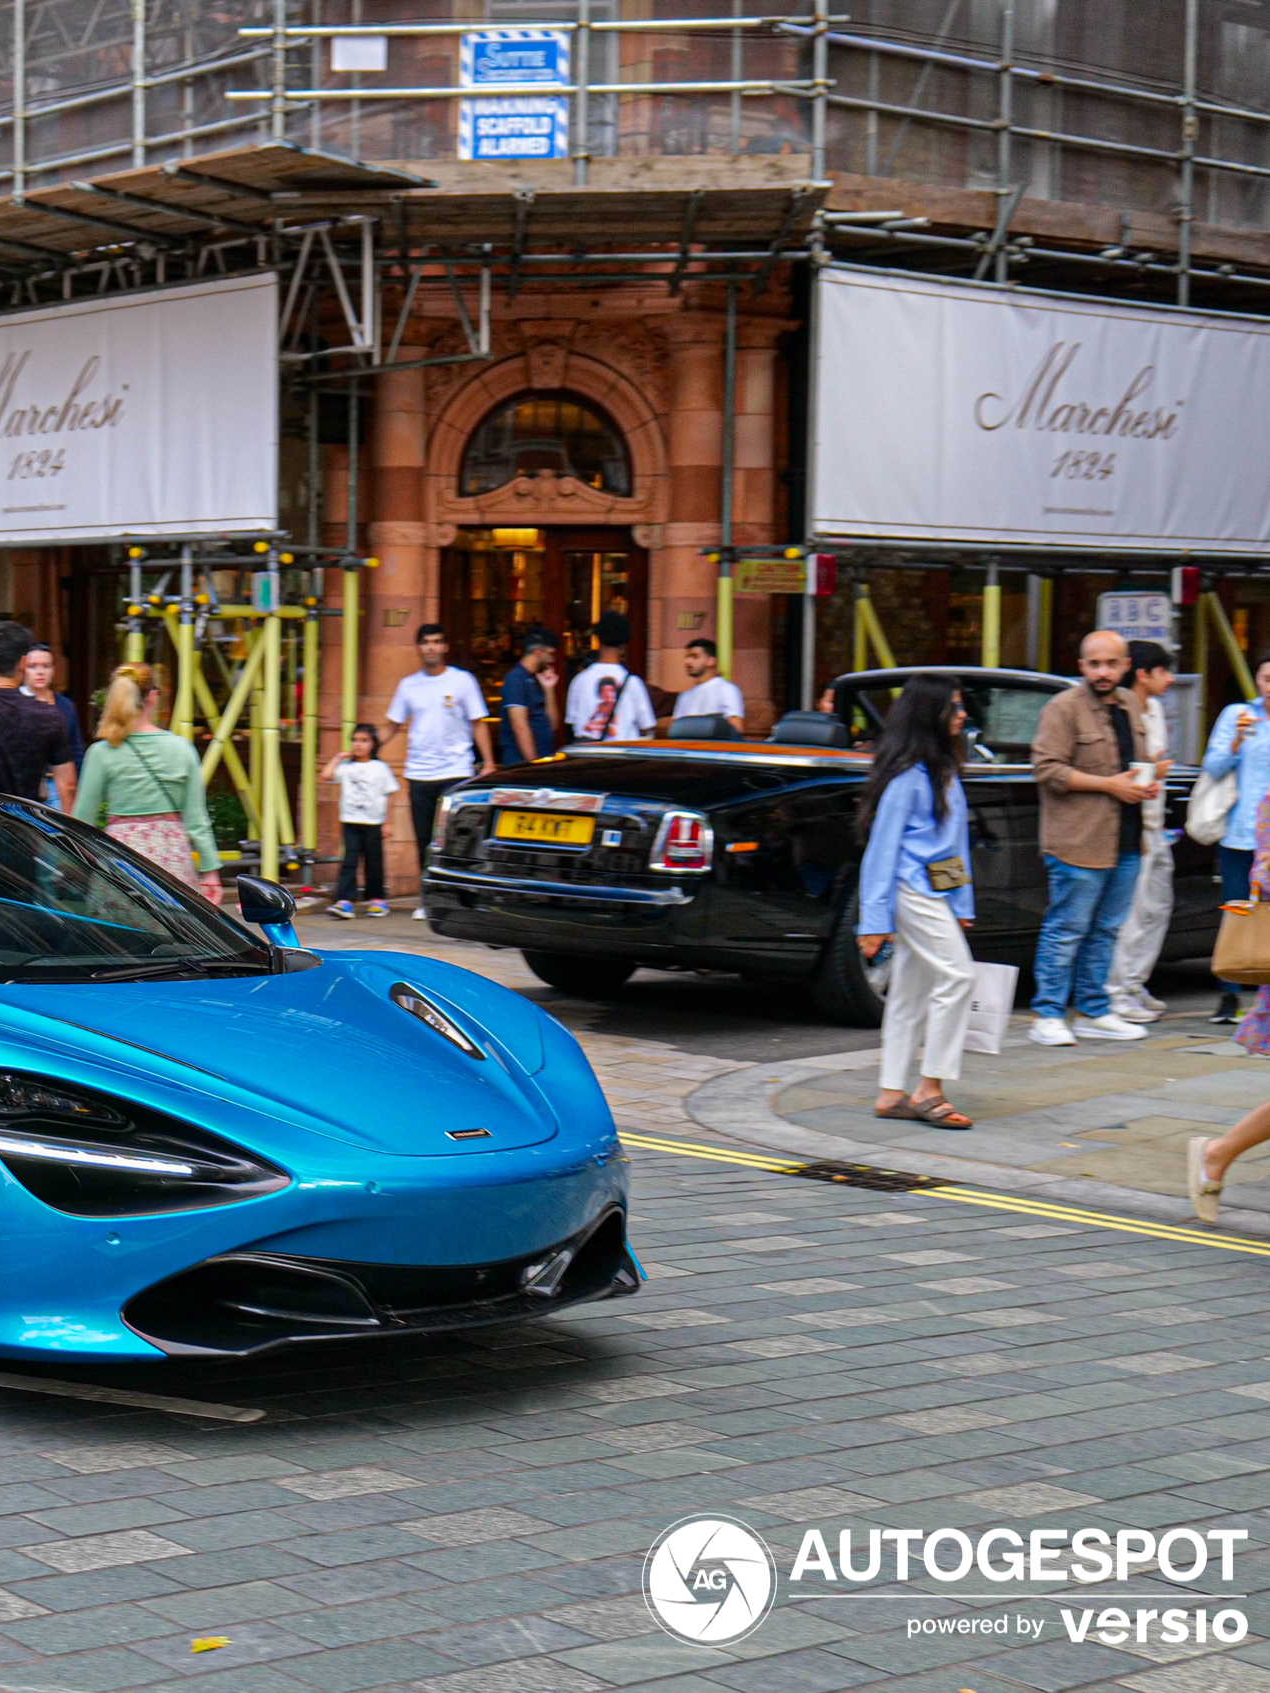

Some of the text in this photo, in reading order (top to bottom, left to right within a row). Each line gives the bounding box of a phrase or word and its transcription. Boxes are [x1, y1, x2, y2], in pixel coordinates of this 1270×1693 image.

[476, 116, 552, 136] SCAFFOLD
[478, 136, 551, 155] ALARMED
[974, 341, 1184, 439] Marchesi
[6, 448, 68, 480] 1824
[1050, 449, 1117, 480] 1824
